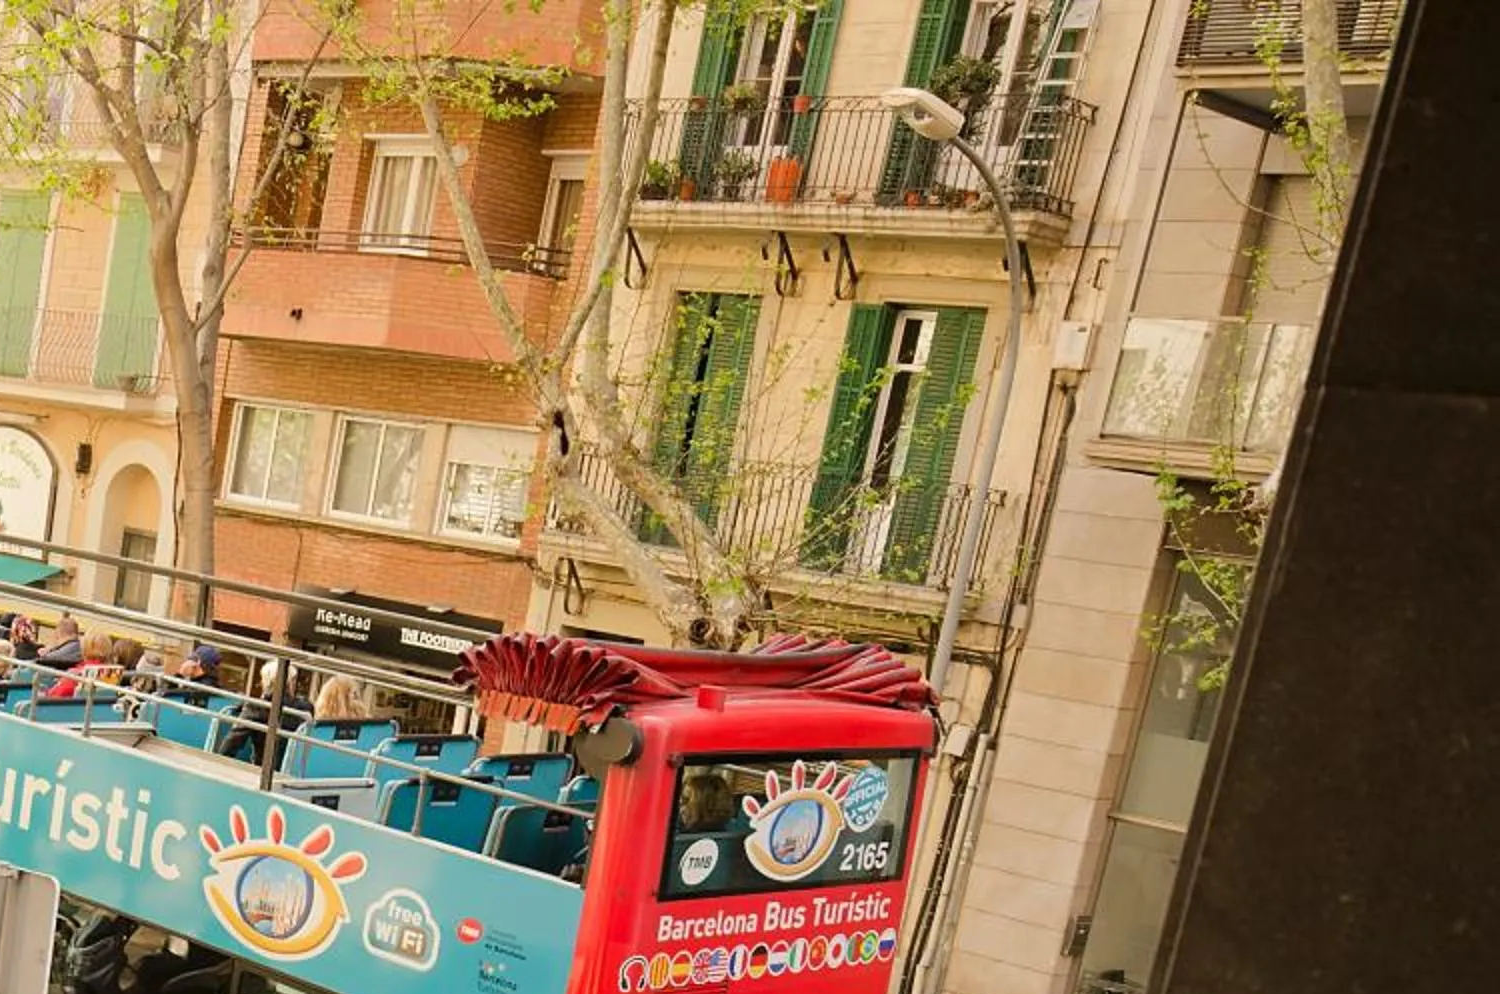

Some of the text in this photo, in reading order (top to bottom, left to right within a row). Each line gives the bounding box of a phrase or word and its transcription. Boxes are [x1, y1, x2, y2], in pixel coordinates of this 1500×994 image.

[839, 841, 889, 872] 2165
[387, 900, 423, 927] free
[657, 892, 892, 942] Barcelona Bus Turístic
